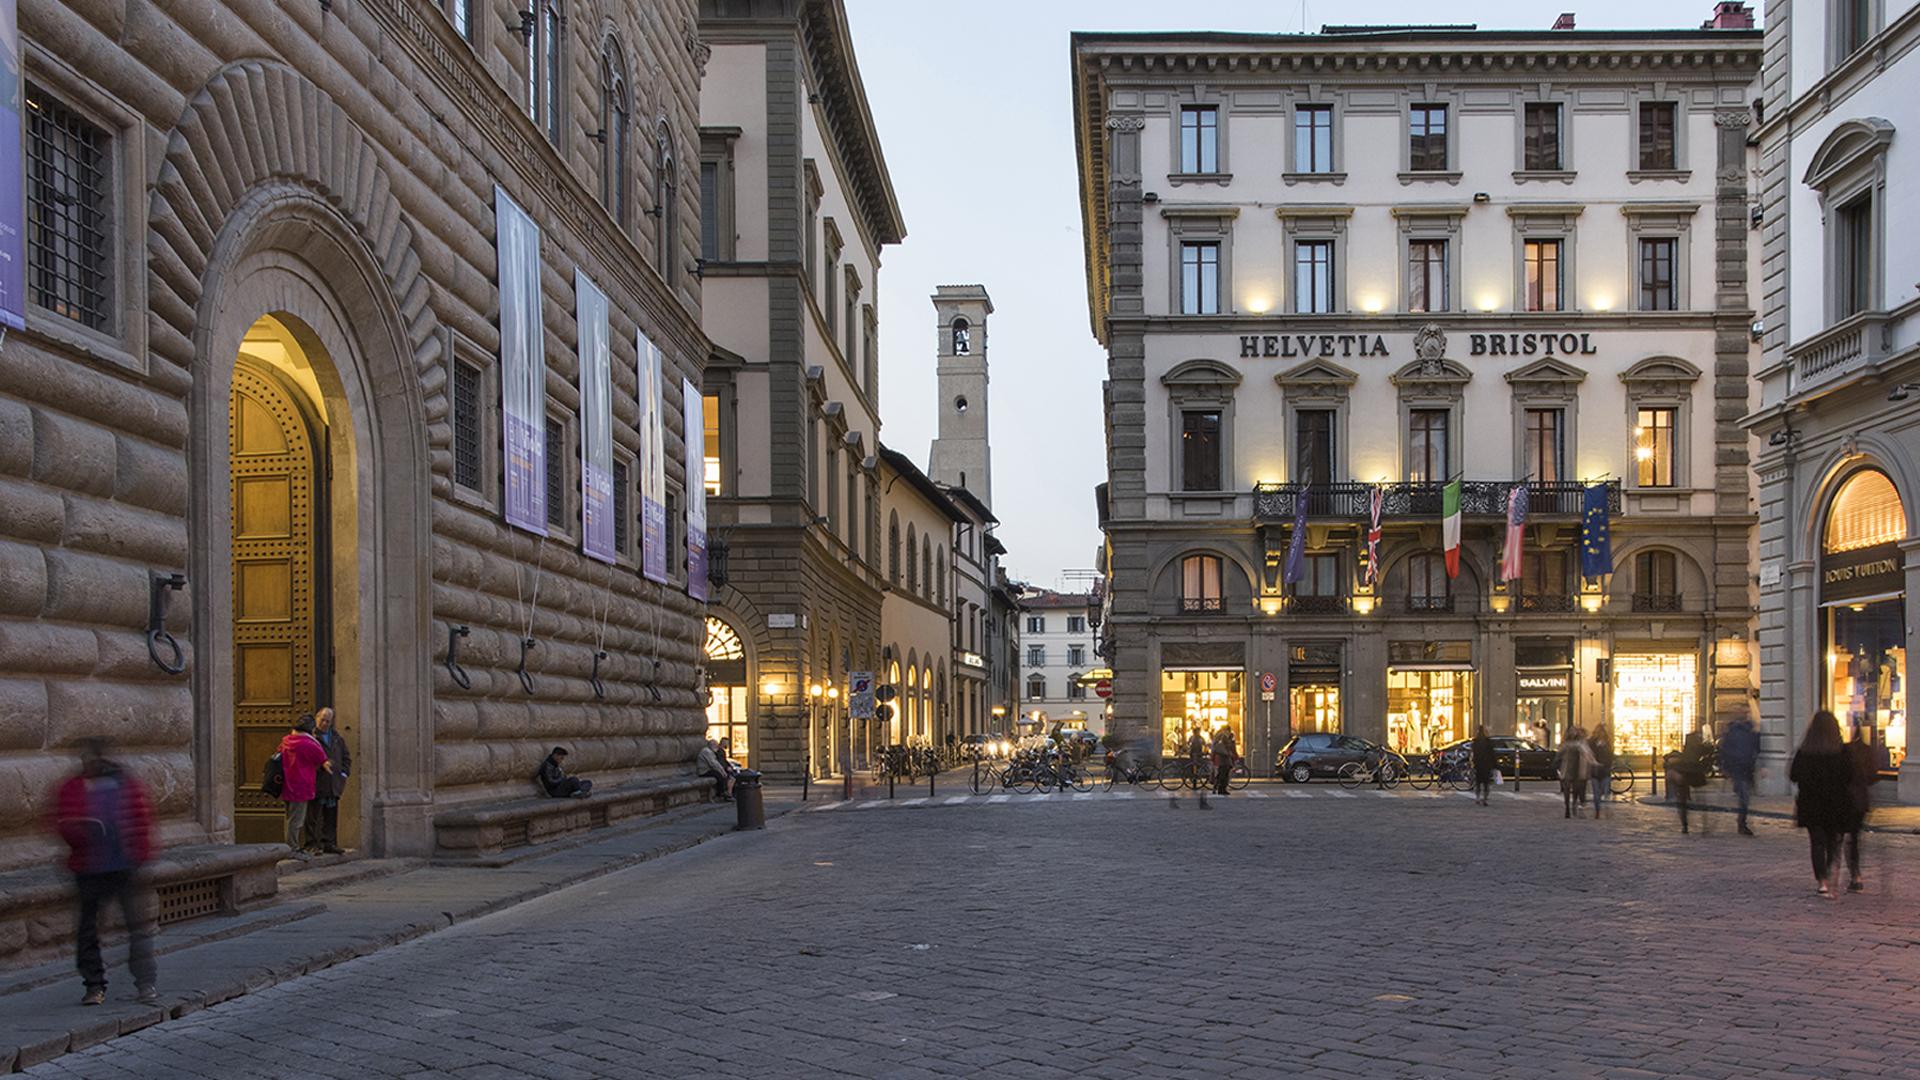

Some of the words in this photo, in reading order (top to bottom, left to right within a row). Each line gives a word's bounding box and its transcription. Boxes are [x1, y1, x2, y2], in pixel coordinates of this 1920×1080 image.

[1240, 335, 1389, 357] HELVETIA
[1470, 334, 1597, 355] BRISTOL
[1825, 566, 1853, 584] LOUIS
[1520, 678, 1566, 688] SALVINI
